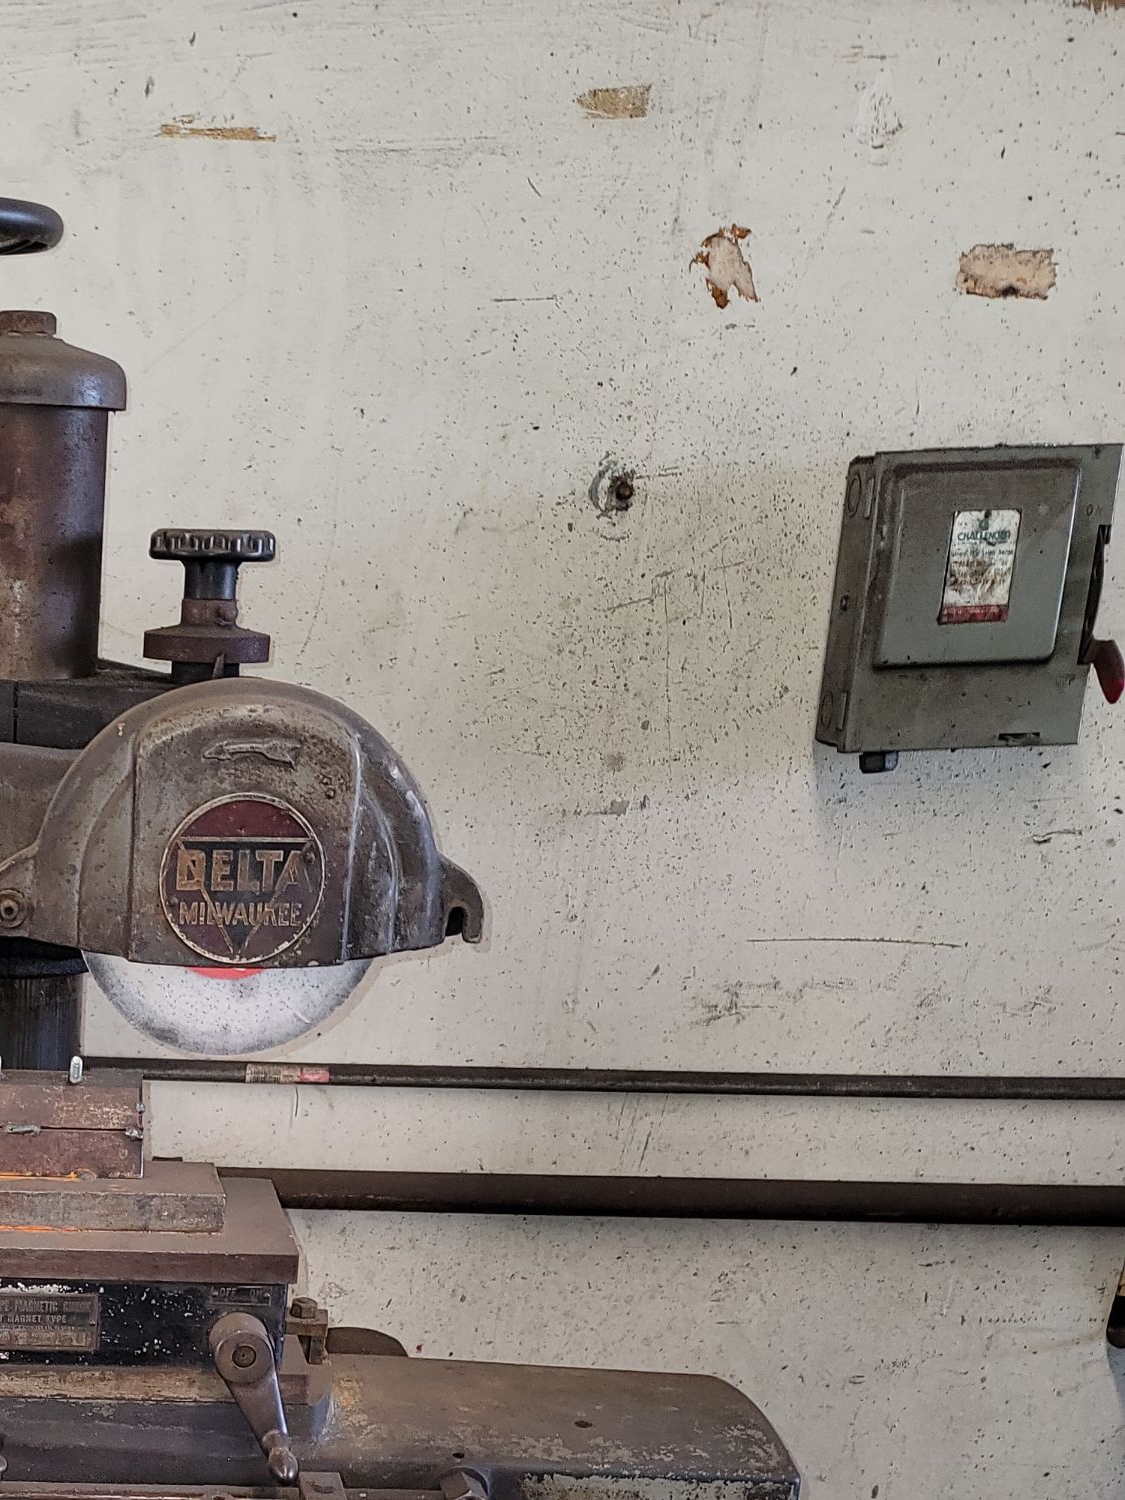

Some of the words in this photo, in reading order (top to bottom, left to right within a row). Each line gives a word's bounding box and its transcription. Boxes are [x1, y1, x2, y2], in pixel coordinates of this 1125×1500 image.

[176, 849, 313, 893] DELTA
[178, 901, 304, 927] MILWAUKEE
[7, 1314, 42, 1323] MAGNET
[46, 1314, 67, 1324] TYPE
